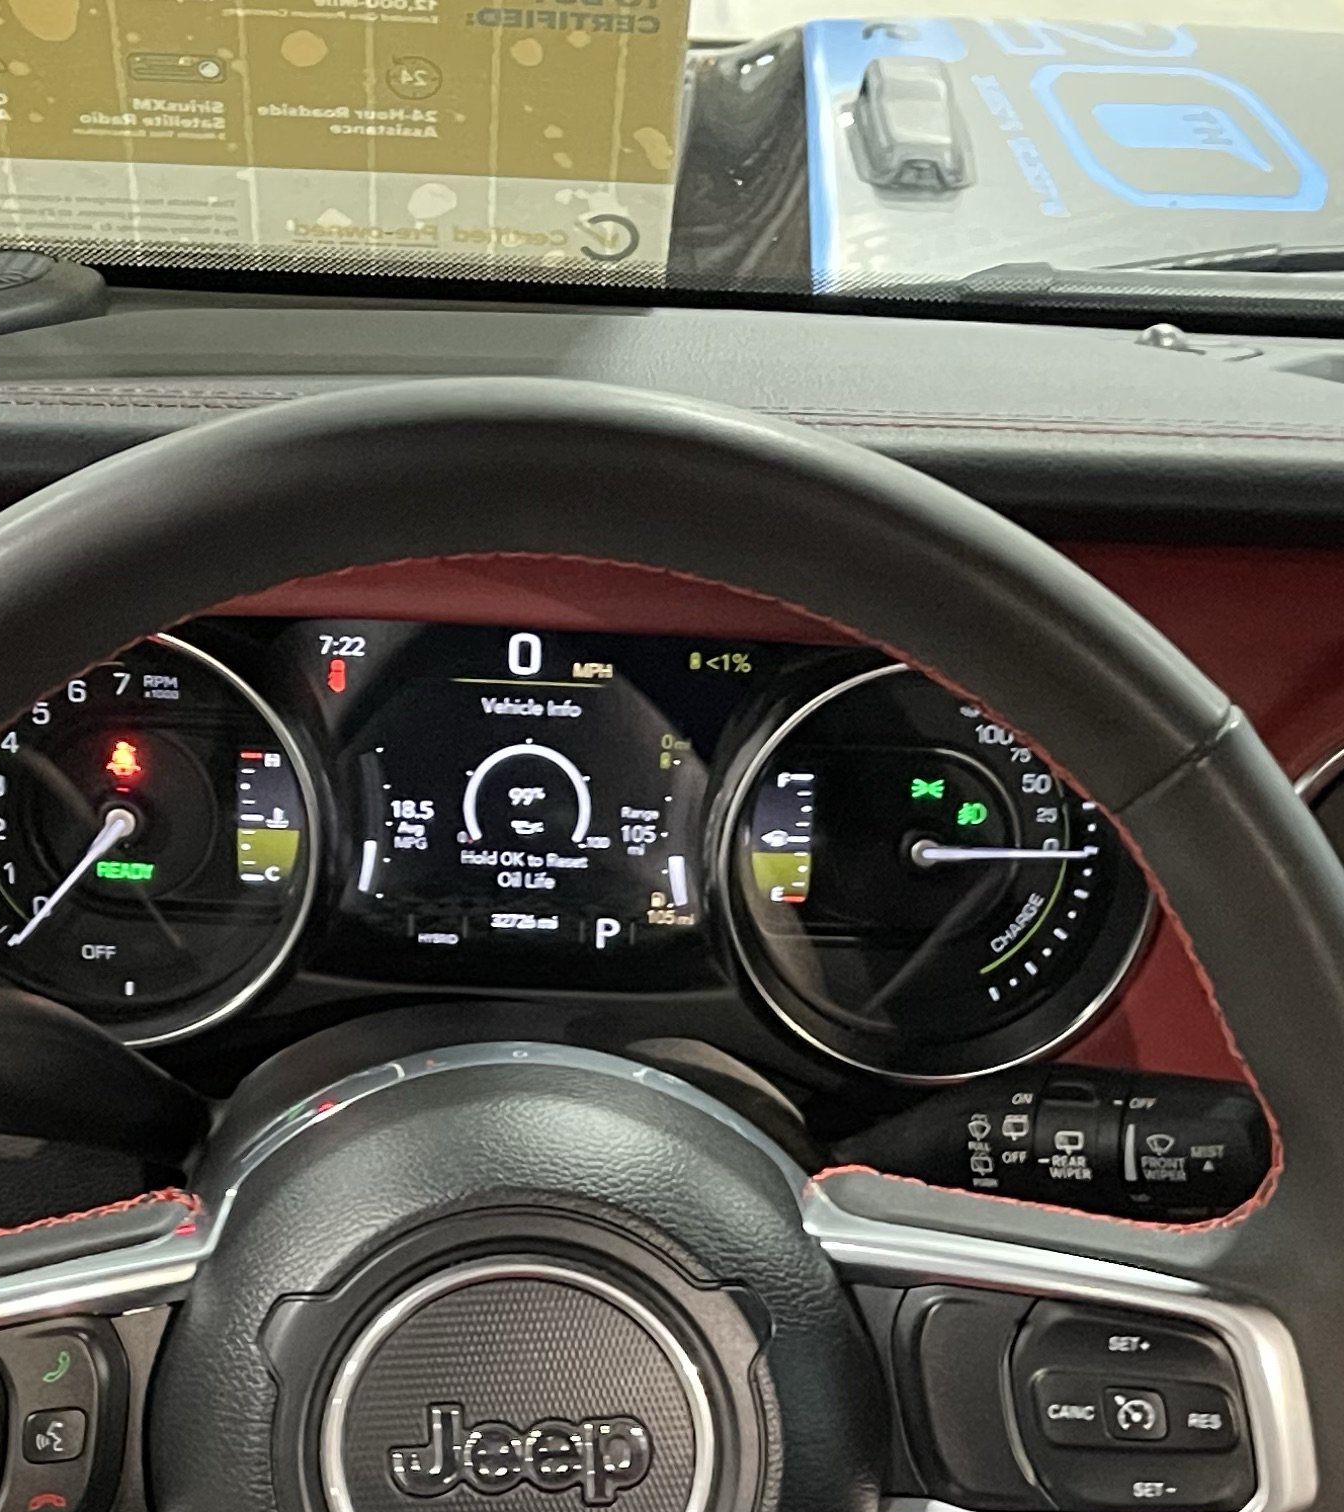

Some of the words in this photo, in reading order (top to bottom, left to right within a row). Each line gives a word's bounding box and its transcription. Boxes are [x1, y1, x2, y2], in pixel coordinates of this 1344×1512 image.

[319, 634, 366, 657] 7:22
[508, 632, 542, 676] 0
[571, 662, 613, 679] MPH
[67, 680, 87, 703] 6
[112, 672, 132, 696] 7
[143, 675, 179, 690] RPM
[32, 702, 51, 725] 5
[481, 697, 543, 716] Vehicle
[546, 699, 583, 718] Info
[0, 732, 20, 754] 4
[660, 734, 674, 751] 0
[1010, 747, 1032, 764] 75
[1022, 773, 1052, 794] 50
[390, 800, 435, 820] 18.5
[1036, 807, 1058, 823] 25
[394, 835, 428, 851] MPG
[620, 824, 657, 844] 105
[460, 850, 498, 867] Hold
[500, 851, 525, 868] OK
[527, 854, 544, 868] to
[3, 863, 16, 885] 1
[96, 862, 155, 881] READY
[265, 865, 280, 882] C
[497, 872, 523, 889] Oil
[524, 872, 556, 890] Life
[647, 909, 676, 925] 105
[989, 891, 1045, 954] CHARGE
[595, 918, 621, 950] P
[81, 944, 117, 961] OFF
[1012, 1092, 1033, 1105] ON
[1128, 1097, 1156, 1109] OFF
[1001, 1150, 1027, 1164] OFF
[1051, 1155, 1087, 1168] REAR
[1141, 1156, 1186, 1170] FRONT
[1049, 1166, 1093, 1180] WIPER
[1143, 1168, 1187, 1181] WIPER
[1047, 1403, 1095, 1422] CANC
[1187, 1412, 1222, 1430] RES
[388, 1403, 653, 1508] Jeep
